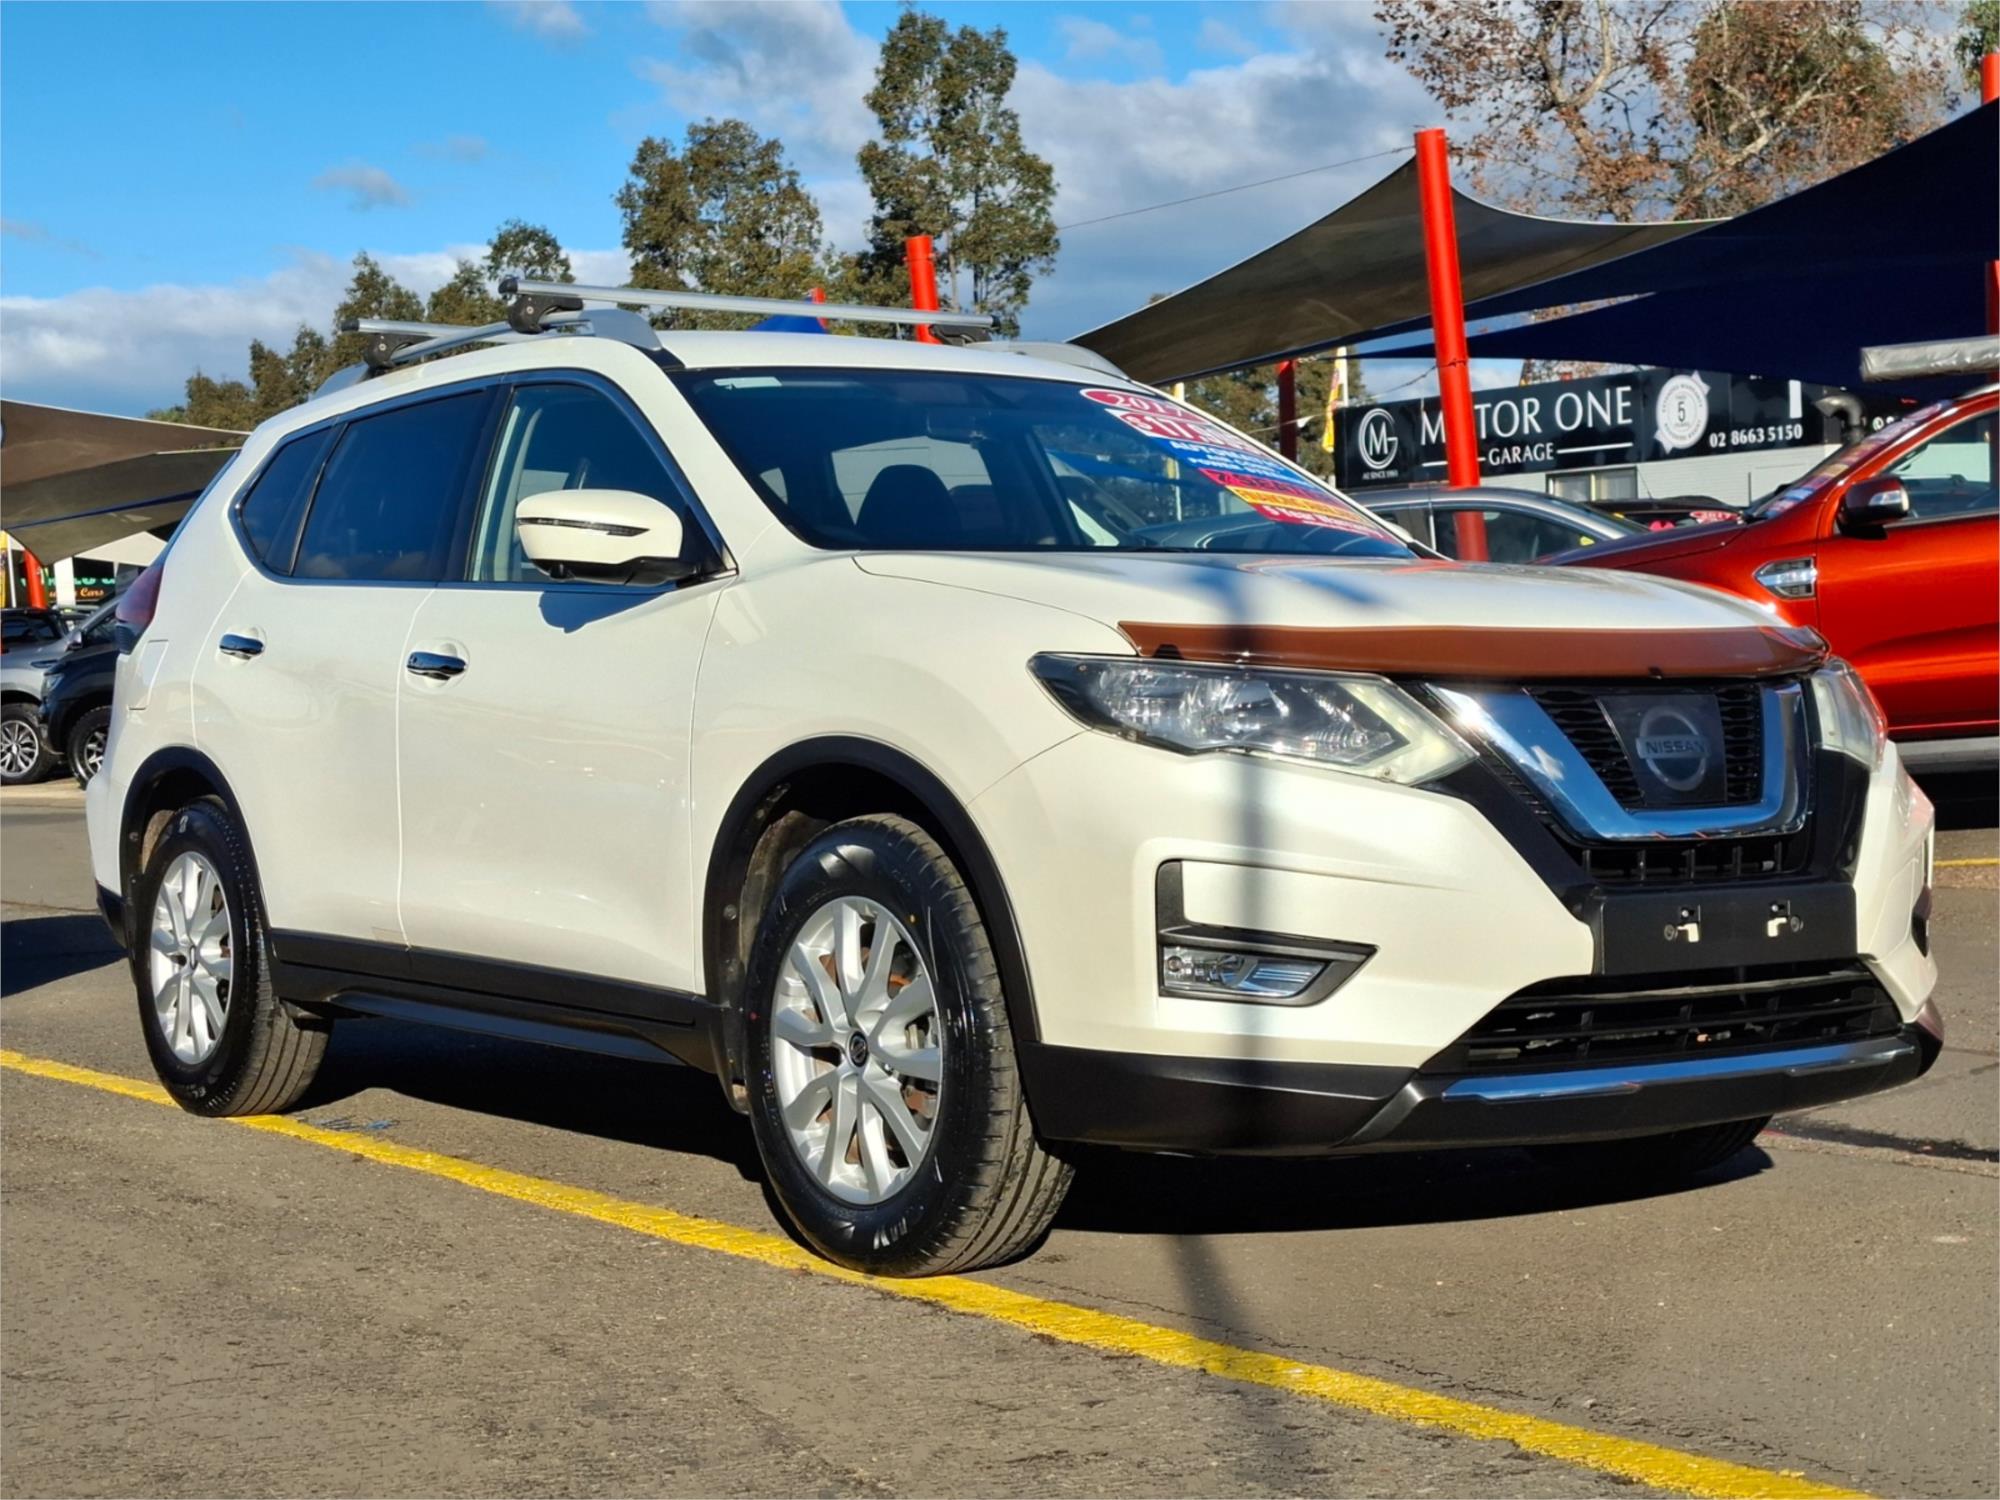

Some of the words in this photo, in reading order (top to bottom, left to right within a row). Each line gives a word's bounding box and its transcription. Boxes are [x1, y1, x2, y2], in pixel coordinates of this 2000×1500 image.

[1106, 393, 1183, 417] 2017
[1420, 398, 1543, 446] MTOR
[1554, 386, 1633, 432] ONE
[1677, 401, 1686, 423] 5
[1709, 434, 1726, 447] 02
[1730, 427, 1765, 445] 8663
[1767, 424, 1803, 443] 5150
[1488, 442, 1554, 467] GARAGE
[1645, 740, 1705, 754] NISSAN
